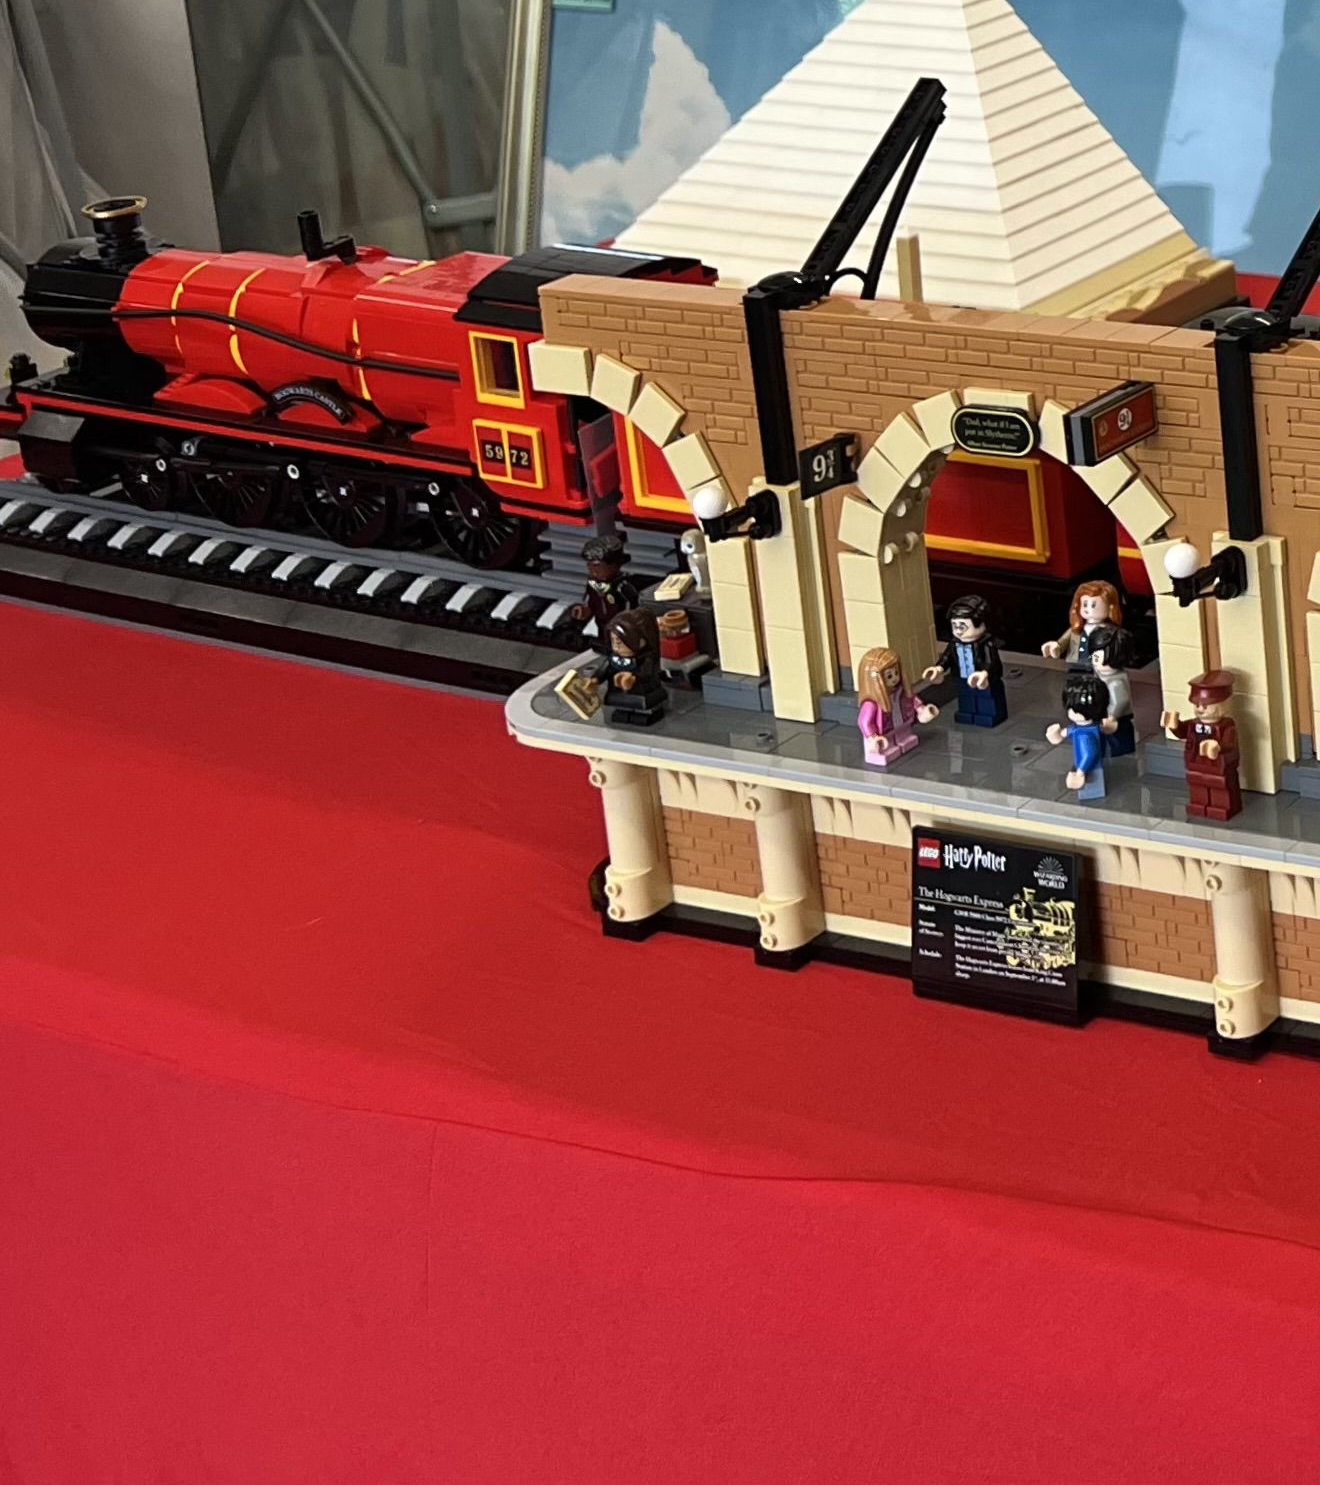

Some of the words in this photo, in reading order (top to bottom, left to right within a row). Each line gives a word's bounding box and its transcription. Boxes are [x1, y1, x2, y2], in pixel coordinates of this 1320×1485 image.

[484, 444, 529, 465] 5972
[918, 846, 940, 860] LEGO
[943, 844, 974, 870] Harry
[973, 845, 1007, 873] Potter
[1032, 870, 1069, 884] WIZARDING
[1038, 878, 1066, 890] WORLD
[918, 886, 935, 899] The
[935, 889, 973, 906] Hogwarts
[973, 894, 1004, 911] Express
